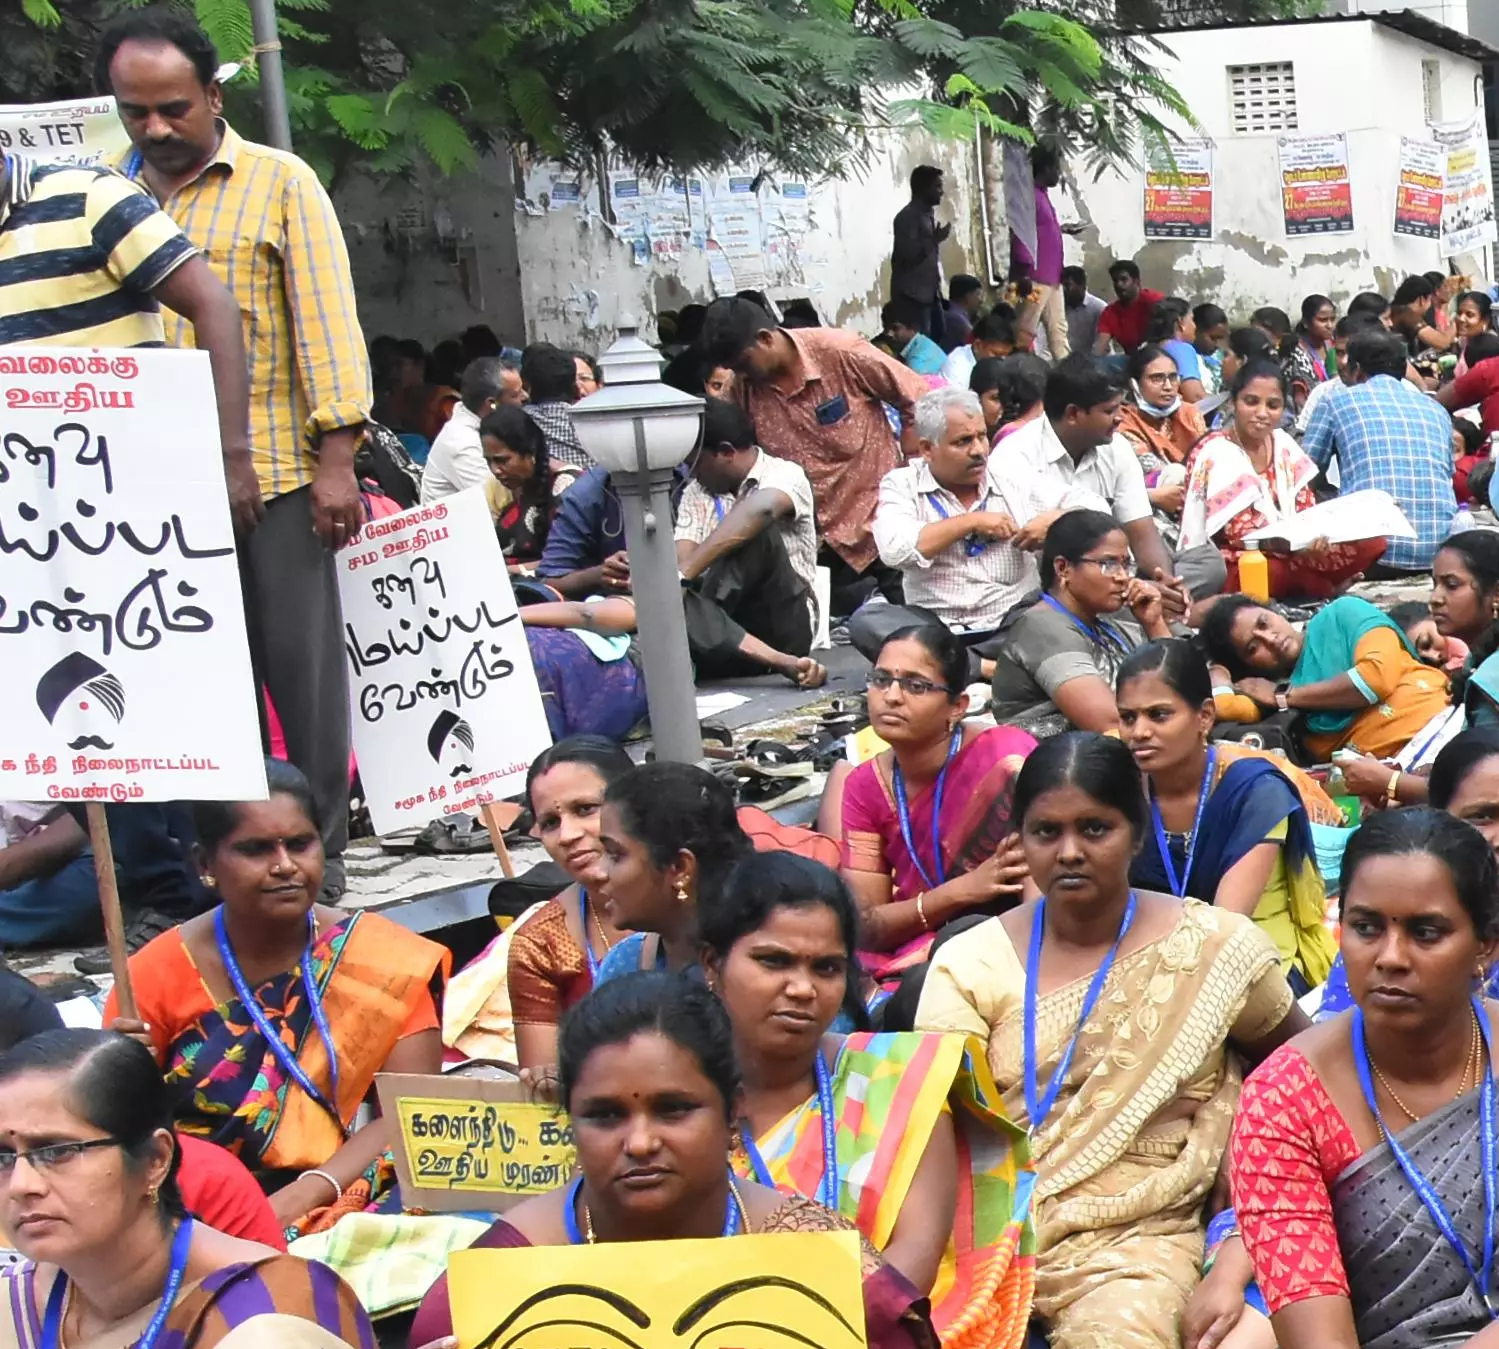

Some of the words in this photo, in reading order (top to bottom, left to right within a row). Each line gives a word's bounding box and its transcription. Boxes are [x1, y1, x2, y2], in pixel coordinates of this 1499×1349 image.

[18, 127, 38, 148] &
[39, 123, 85, 146] TET
[5, 382, 135, 414] ஊதிய
[365, 502, 449, 541] வேலைக்கு
[348, 551, 379, 571] சம
[382, 526, 450, 559] ஊதிய
[359, 640, 514, 722] வேண்டும்
[25, 753, 58, 775] நீதி
[72, 754, 220, 775] நிலைநாட்டப்பட
[47, 781, 144, 802] வேண்டும்
